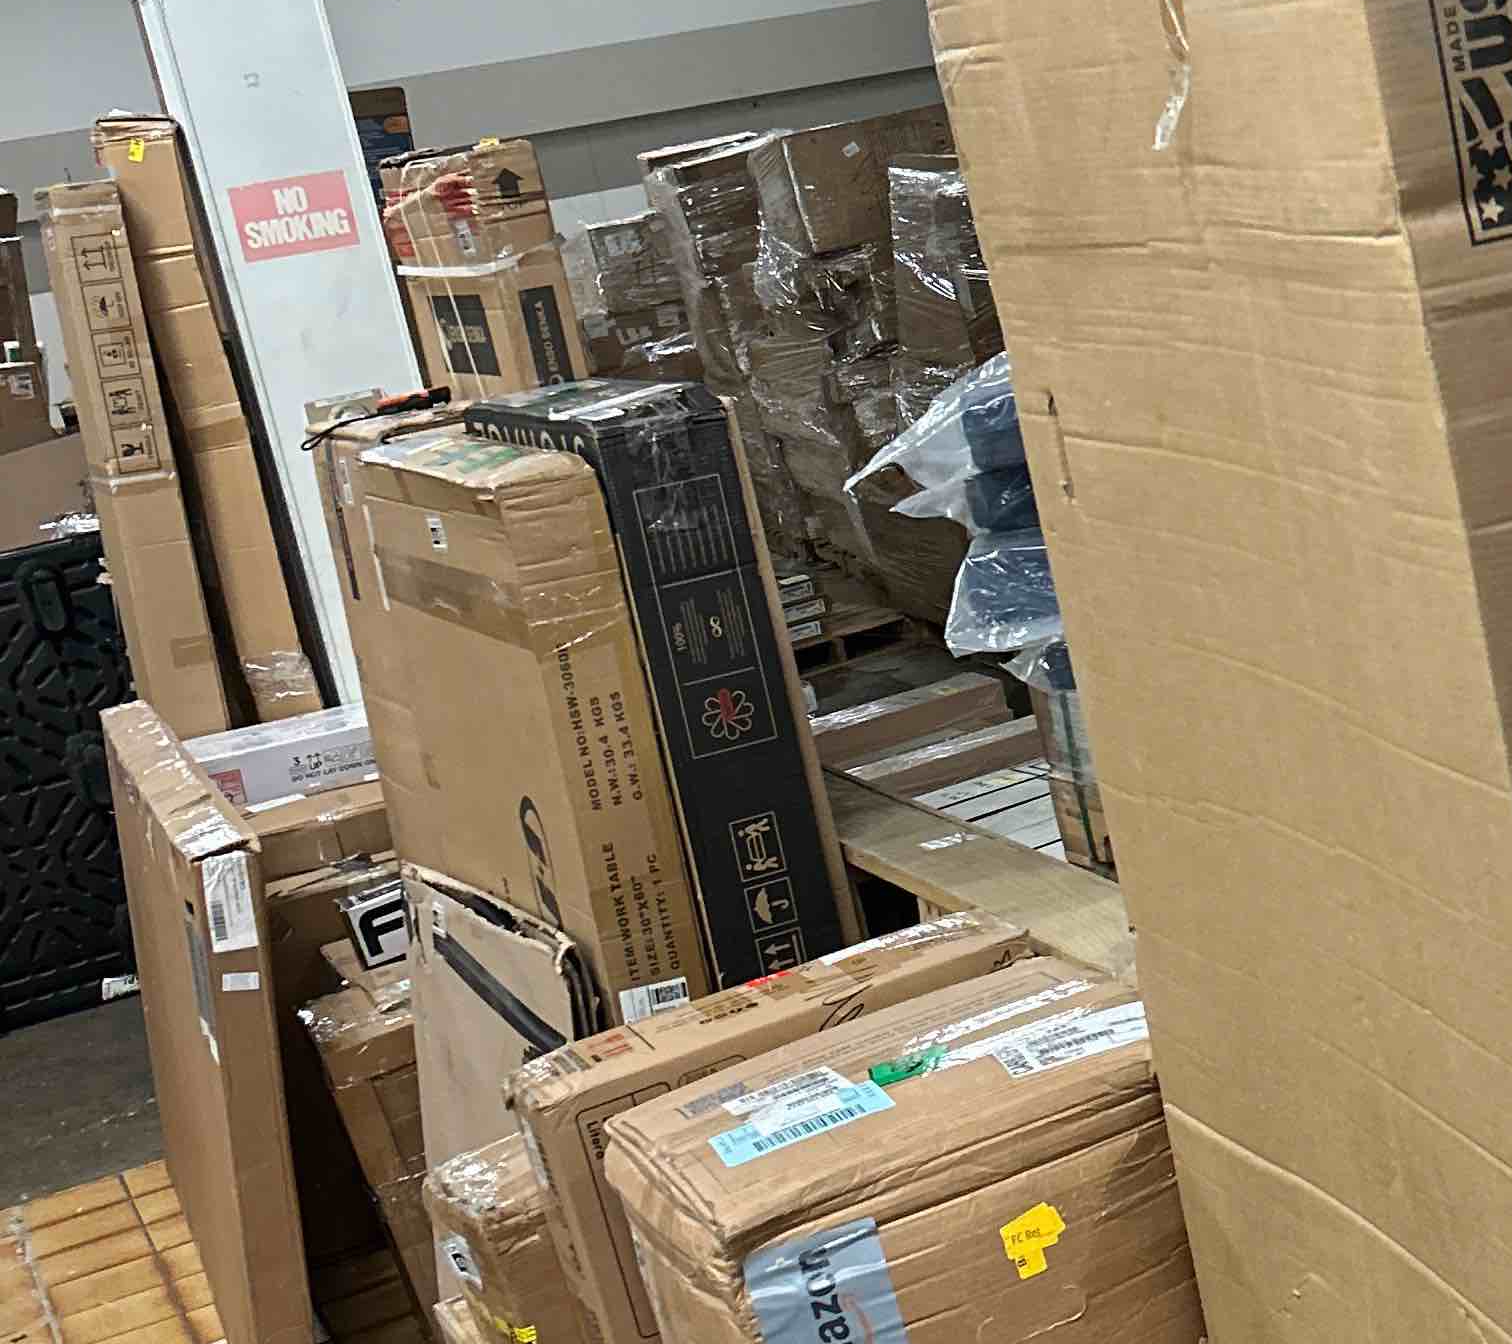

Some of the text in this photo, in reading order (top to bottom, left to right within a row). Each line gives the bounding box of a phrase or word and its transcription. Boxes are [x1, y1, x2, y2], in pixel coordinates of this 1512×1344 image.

[1444, 6, 1466, 72] MADE
[272, 186, 308, 215] NO
[244, 208, 350, 249] SMOKING
[583, 759, 603, 810] MODEL
[602, 841, 621, 892] TABLE
